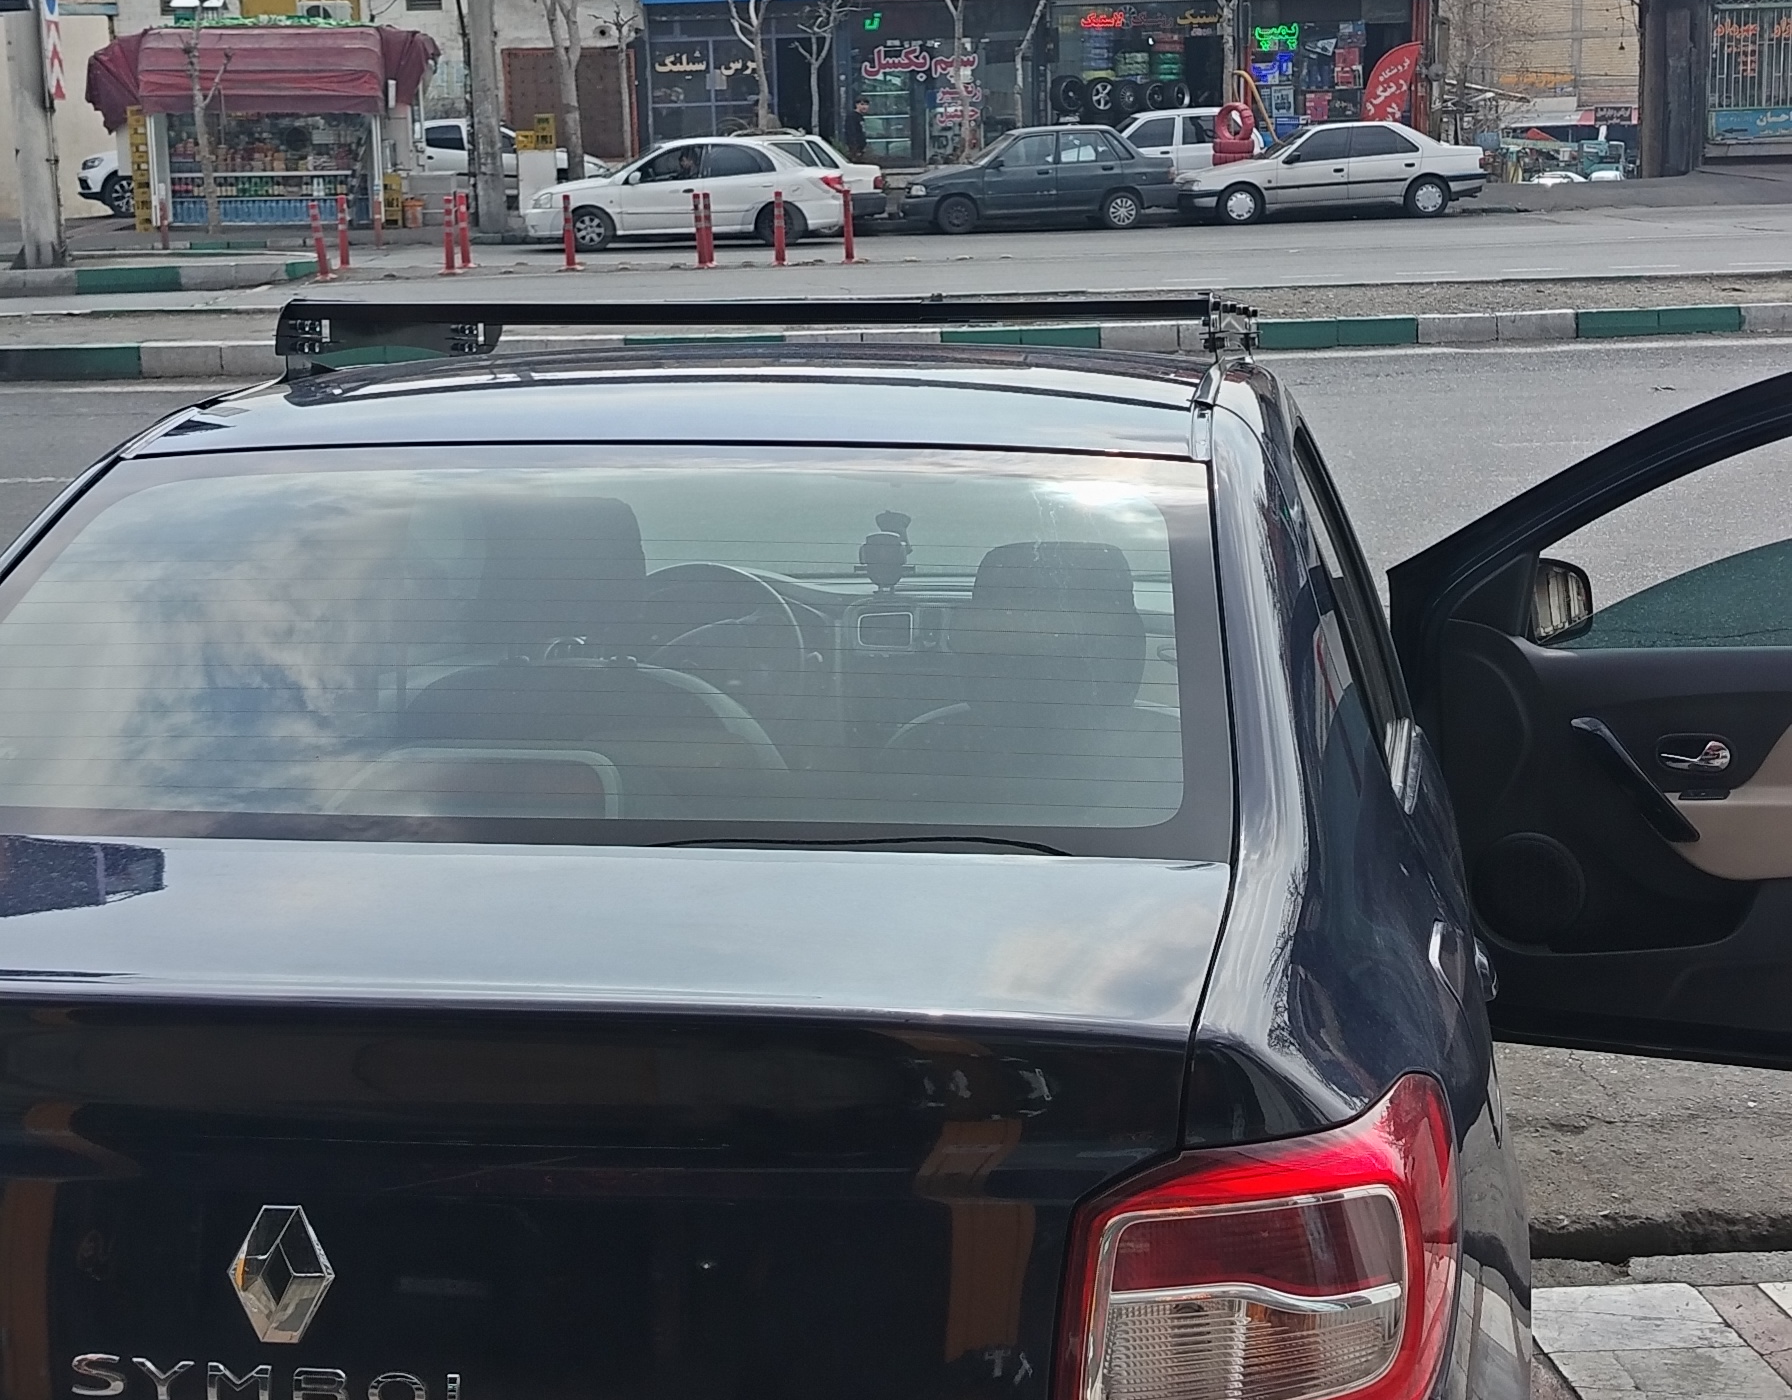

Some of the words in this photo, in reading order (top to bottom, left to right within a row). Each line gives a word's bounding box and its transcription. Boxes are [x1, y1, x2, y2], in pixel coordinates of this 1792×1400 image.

[1254, 23, 1299, 51] پمپ
[655, 50, 707, 80] شیلنگ
[862, 46, 930, 82] بکسل
